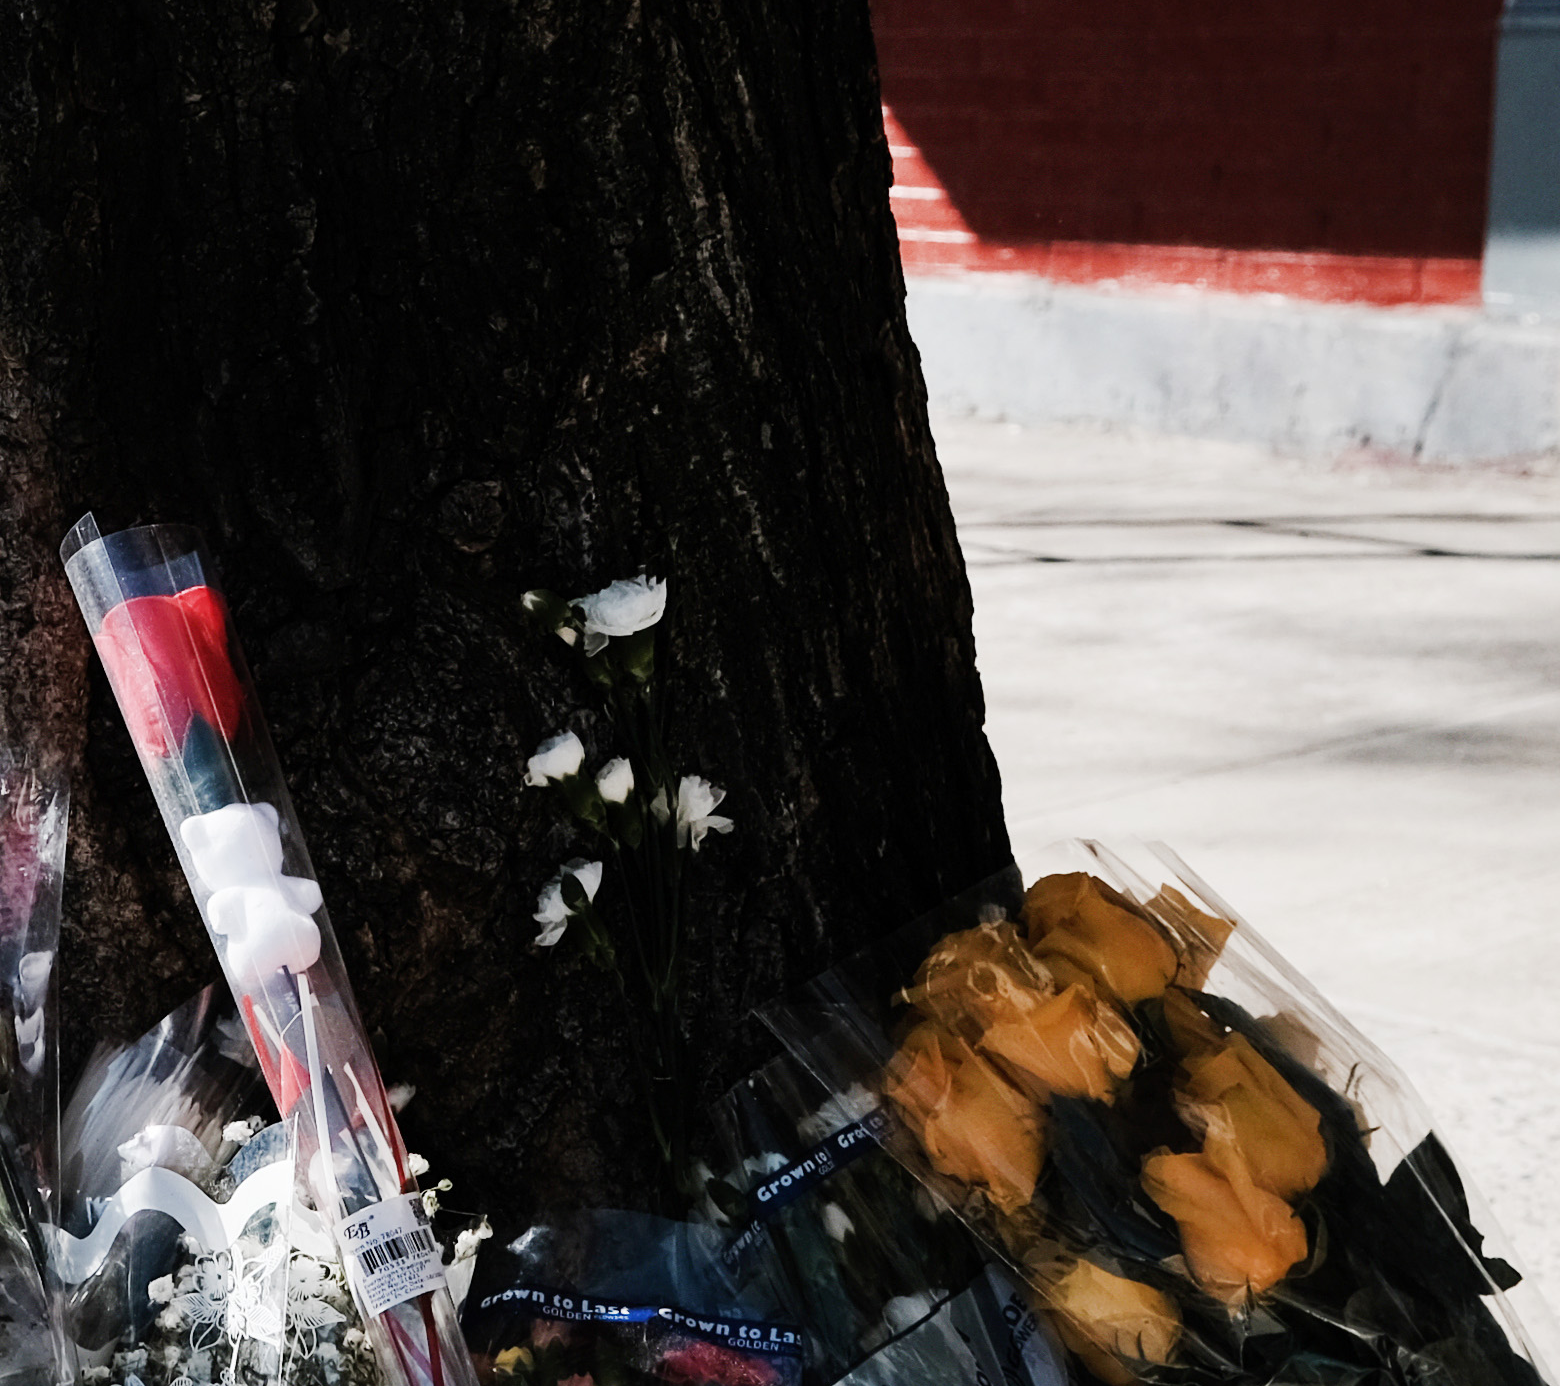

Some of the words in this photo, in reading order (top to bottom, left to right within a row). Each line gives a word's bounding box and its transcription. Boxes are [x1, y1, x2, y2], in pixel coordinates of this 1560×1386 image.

[757, 1158, 816, 1203] Grown
[481, 1289, 545, 1309] Grown
[553, 1294, 574, 1310] to
[582, 1299, 631, 1316] Last
[542, 1305, 591, 1321] GOLDEN
[658, 1307, 730, 1336] Grown
[739, 1324, 761, 1340] to
[769, 1327, 802, 1345] Las
[728, 1336, 779, 1352] GOLDEN
